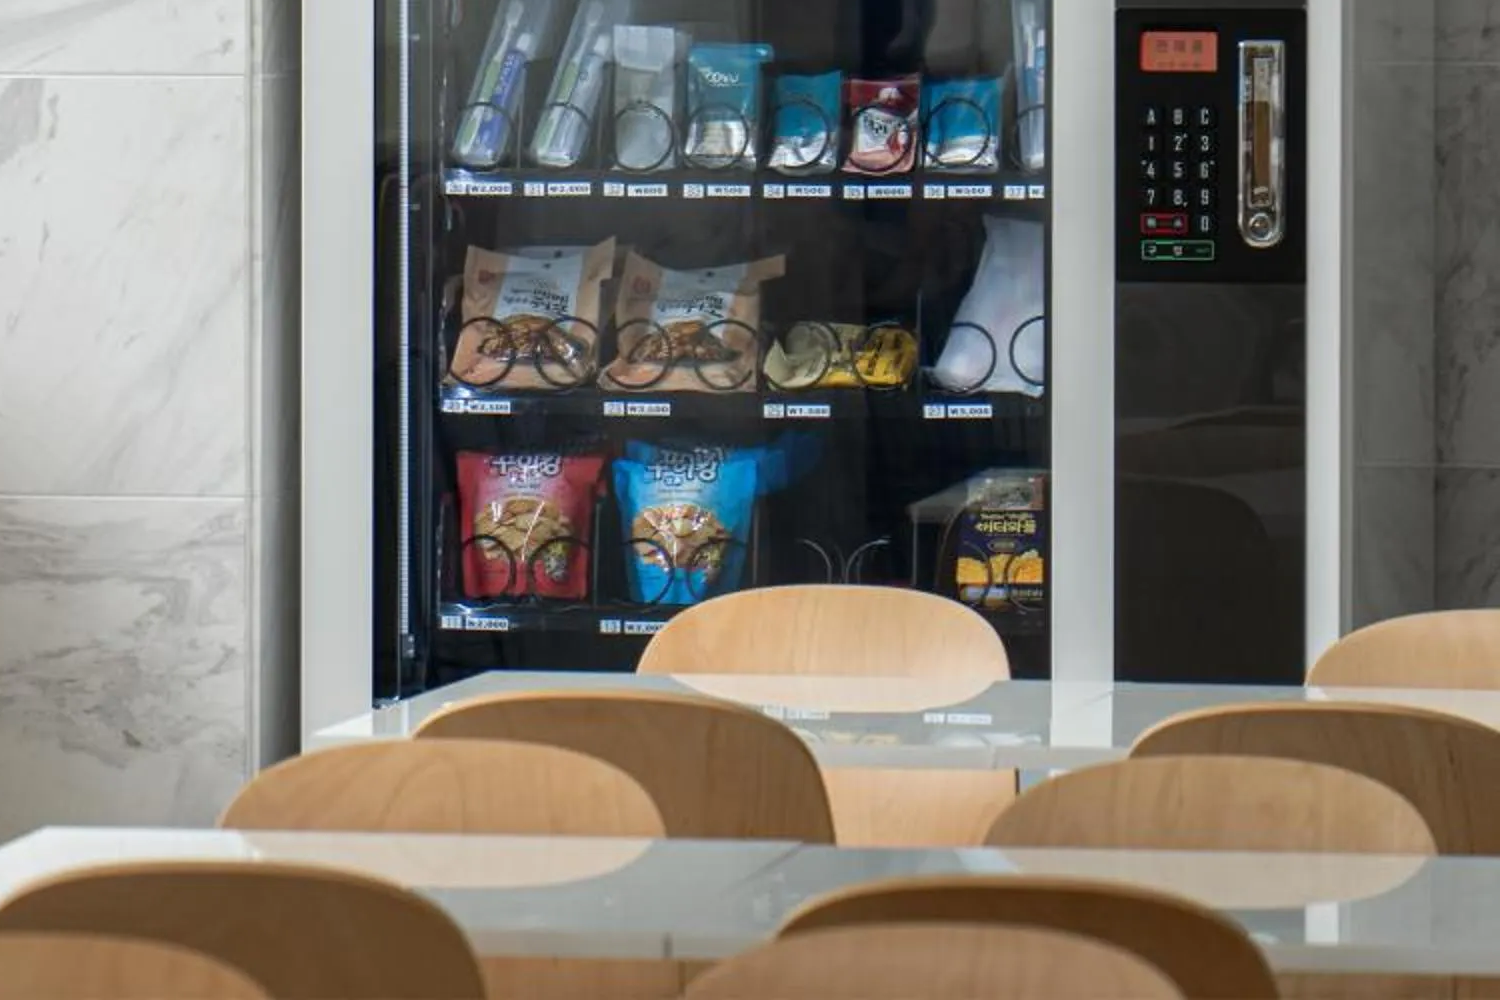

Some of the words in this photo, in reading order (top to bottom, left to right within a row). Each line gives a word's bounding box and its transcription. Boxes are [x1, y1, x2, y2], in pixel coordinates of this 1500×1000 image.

[1147, 108, 1156, 125] A
[1173, 108, 1183, 125] B
[1201, 108, 1210, 125] C
[1174, 135, 1182, 151] 2
[1201, 135, 1209, 151] 3
[1147, 161, 1155, 178] 4
[1173, 161, 1183, 178] 5
[1201, 162, 1209, 178] 6
[1147, 189, 1155, 205] 7
[1173, 189, 1183, 205] 8
[1201, 189, 1209, 205] 9
[1201, 215, 1210, 232] 0
